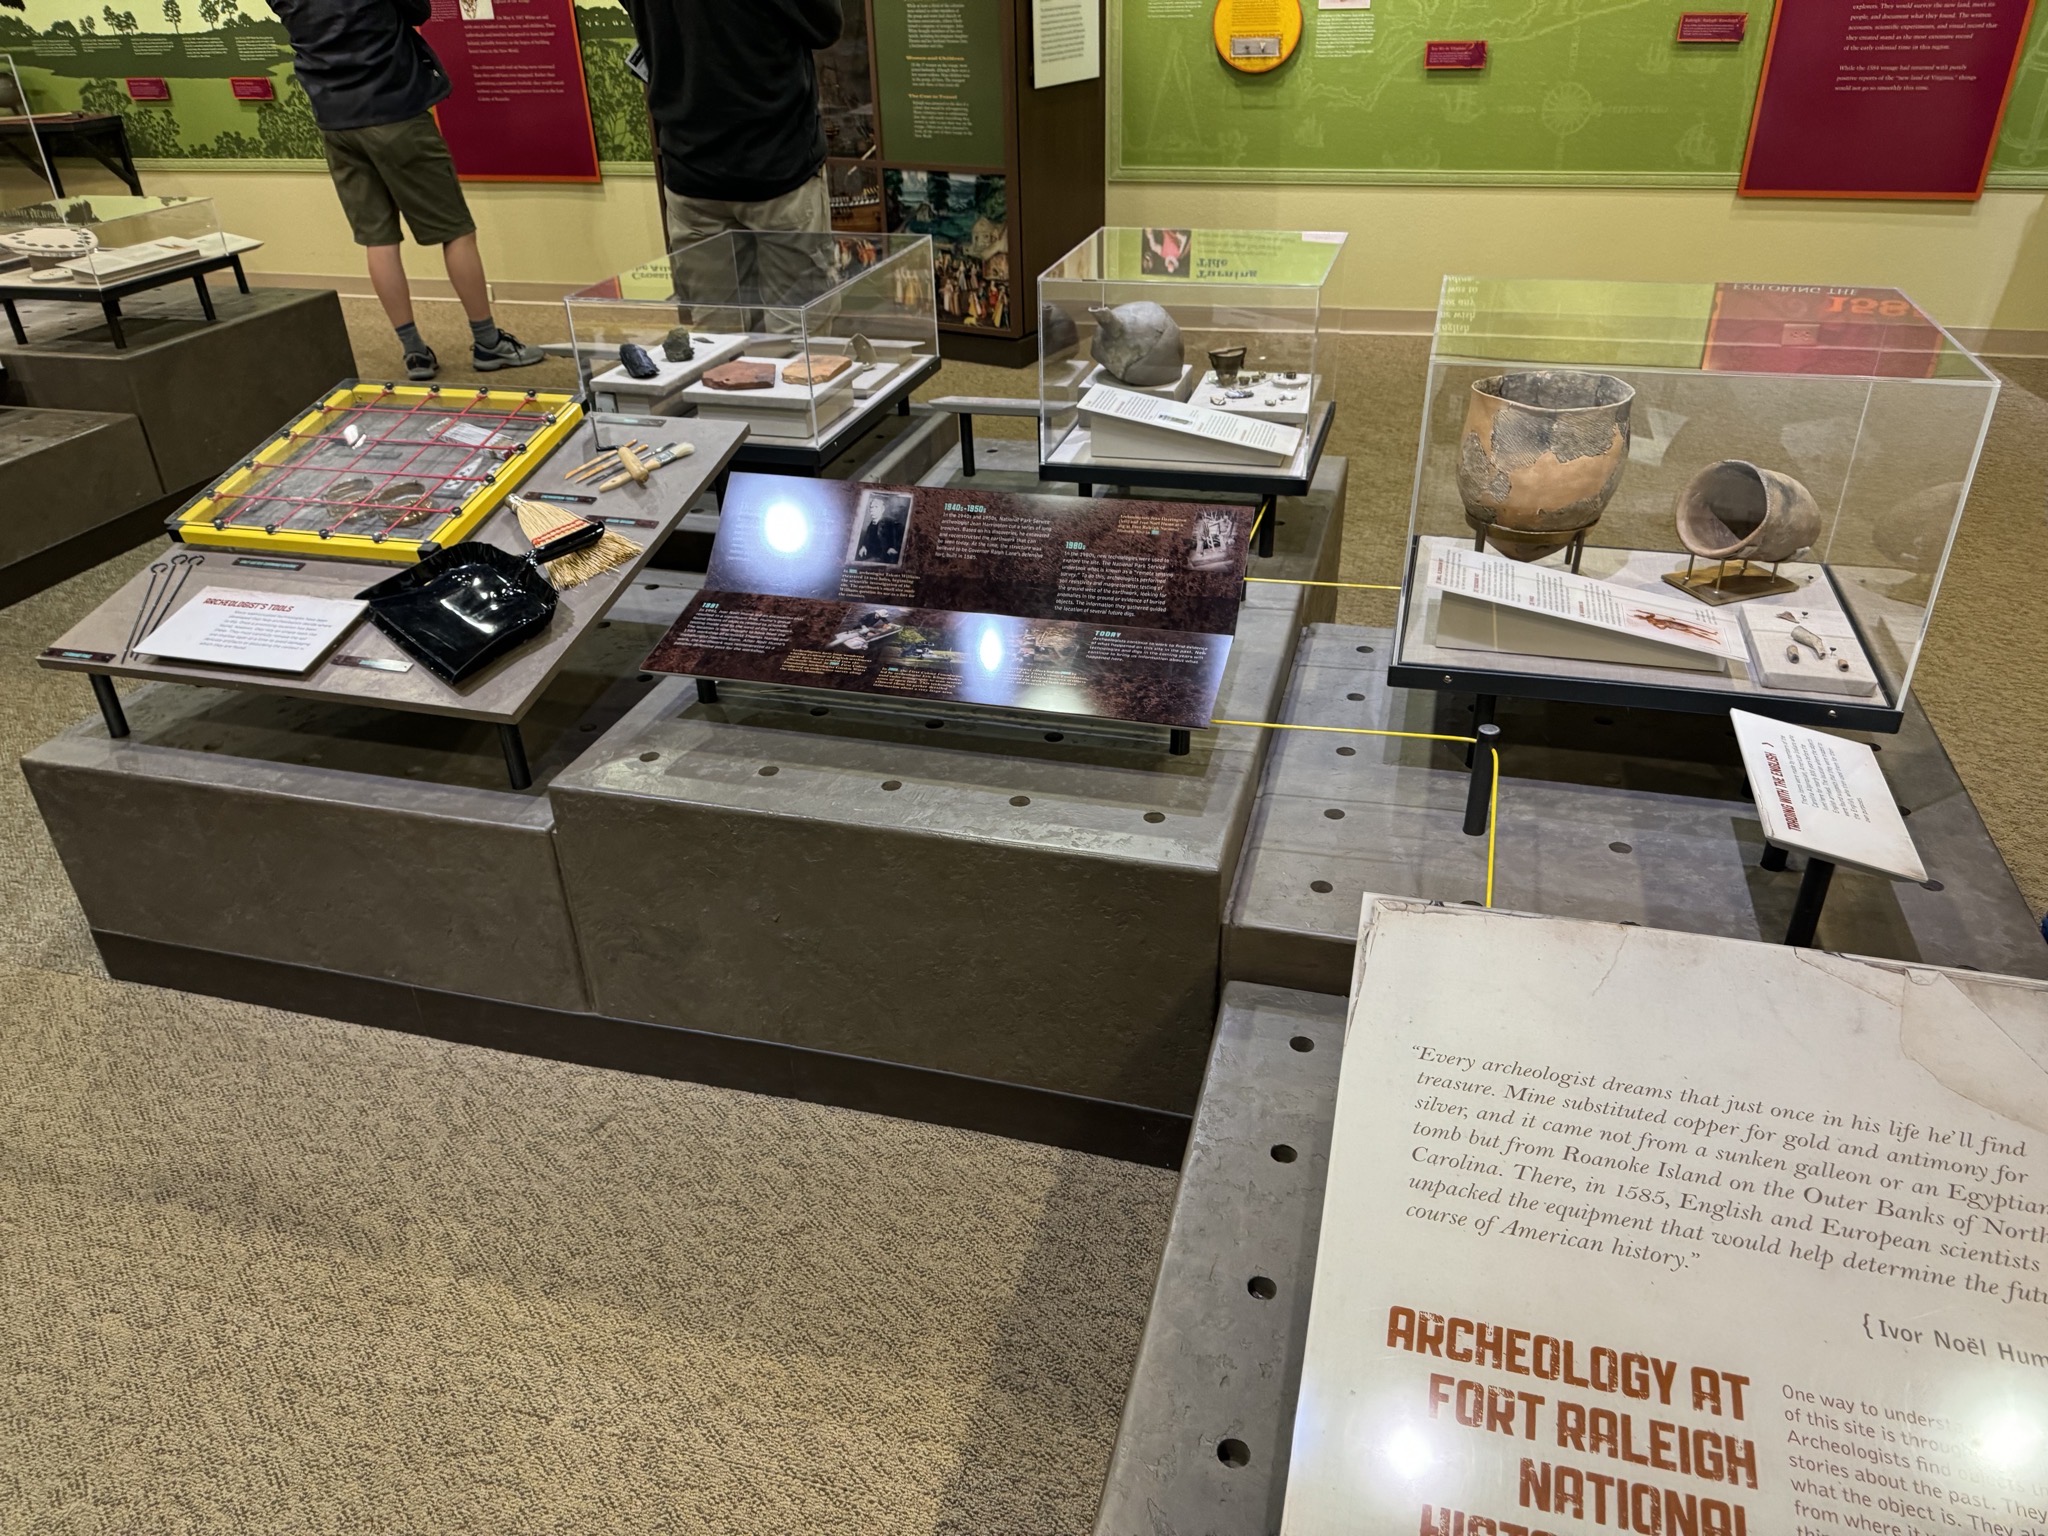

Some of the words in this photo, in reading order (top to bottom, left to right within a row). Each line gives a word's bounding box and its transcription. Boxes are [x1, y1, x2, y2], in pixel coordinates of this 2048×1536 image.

[1065, 541, 1086, 550] 1980s
[268, 604, 295, 612] TOOLS
[1095, 630, 1122, 638] TODAY
[1764, 751, 1783, 777] ENGLISH
[1772, 776, 1787, 788] THE
[1776, 787, 1792, 804] WITH
[1781, 803, 1801, 832] TRADING
[1417, 1072, 1494, 1096] treasure.
[1504, 1084, 1556, 1105] Mine
[1562, 1097, 1667, 1124] substituted
[1674, 1117, 1740, 1137] copper
[1740, 1124, 1776, 1143] for
[1782, 1133, 1830, 1151] gold
[1838, 1142, 1878, 1158] and
[1887, 1152, 1988, 1182] antimony
[1991, 1165, 2028, 1185] for
[1482, 1061, 1596, 1088] archeologist
[1603, 1076, 1672, 1099] dreams
[1680, 1088, 1720, 1108] that
[1722, 1096, 1763, 1114] just
[1771, 1107, 1814, 1122] once
[1824, 1110, 1843, 1127] in
[1852, 1114, 1880, 1133] his
[1890, 1120, 1919, 1142] life
[1976, 1136, 2026, 1157] find
[1415, 1096, 1468, 1119] silver,
[1477, 1110, 1515, 1124] and
[1522, 1113, 1535, 1128] it
[1543, 1121, 1592, 1137] came
[1600, 1130, 1633, 1145] not
[1632, 1132, 1688, 1154] from
[1696, 1147, 1707, 1157] a
[1716, 1150, 1786, 1170] sunken
[1794, 1161, 1871, 1185] galleon
[1880, 1178, 1904, 1190] or
[1912, 1183, 1938, 1196] an
[1413, 1122, 1461, 1141] tomb
[1469, 1129, 1500, 1149] but
[1500, 1136, 1555, 1158] from
[1562, 1146, 1649, 1174] Roanoke
[1657, 1162, 1722, 1186] Island
[1730, 1180, 1754, 1192] on
[1764, 1180, 1794, 1199] the
[1804, 1187, 1868, 1211] Outer
[1876, 1199, 1944, 1226] Banks
[1953, 1214, 1978, 1236] of
[1406, 1206, 1467, 1226] course
[1474, 1216, 1500, 1236] of
[1499, 1220, 1603, 1252] American
[1412, 1147, 1502, 1176] Carolina.
[1514, 1164, 1576, 1192] There,
[1586, 1176, 1605, 1194] in
[1616, 1185, 1670, 1209] 1585,
[1678, 1193, 1762, 1222] English
[1771, 1214, 1812, 1231] and
[1821, 1218, 1930, 1252] European
[1940, 1242, 2039, 1272] scientists
[1410, 1178, 1502, 1204] unpacked
[1508, 1192, 1539, 1210] the
[1546, 1202, 1653, 1231] equipment
[1661, 1219, 1704, 1240] that
[1712, 1232, 1781, 1254] would
[1790, 1240, 1833, 1270] help
[1843, 1251, 1955, 1287] determine
[1965, 1274, 1998, 1294] the
[1387, 1305, 1677, 1406] ARCHEOLOGY
[1691, 1366, 1750, 1421] AT
[1934, 1330, 1986, 1356] Noël
[1782, 1384, 1815, 1404] One
[1820, 1394, 1854, 1414] way
[1860, 1401, 1878, 1416] to
[1429, 1372, 1545, 1441] FORT
[1557, 1400, 1758, 1489] RALEIGH
[1784, 1408, 1801, 1422] of
[1806, 1412, 1839, 1430] this
[1844, 1420, 1875, 1438] site
[1881, 1426, 1896, 1442] is
[1788, 1430, 1910, 1469] Archeologists
[1916, 1456, 1951, 1476] find
[1789, 1456, 1849, 1478] stories
[1855, 1468, 1908, 1492] about
[1913, 1479, 1942, 1499] the
[1949, 1489, 1995, 1511] past.
[2000, 1497, 2047, 1524] They
[1790, 1478, 1836, 1500] what
[1842, 1488, 1871, 1507] the
[1878, 1496, 1935, 1522] object
[1941, 1508, 1961, 1527] is.
[1967, 1514, 2013, 1536] They
[1794, 1500, 1839, 1524] from
[1844, 1514, 1901, 1536] where
